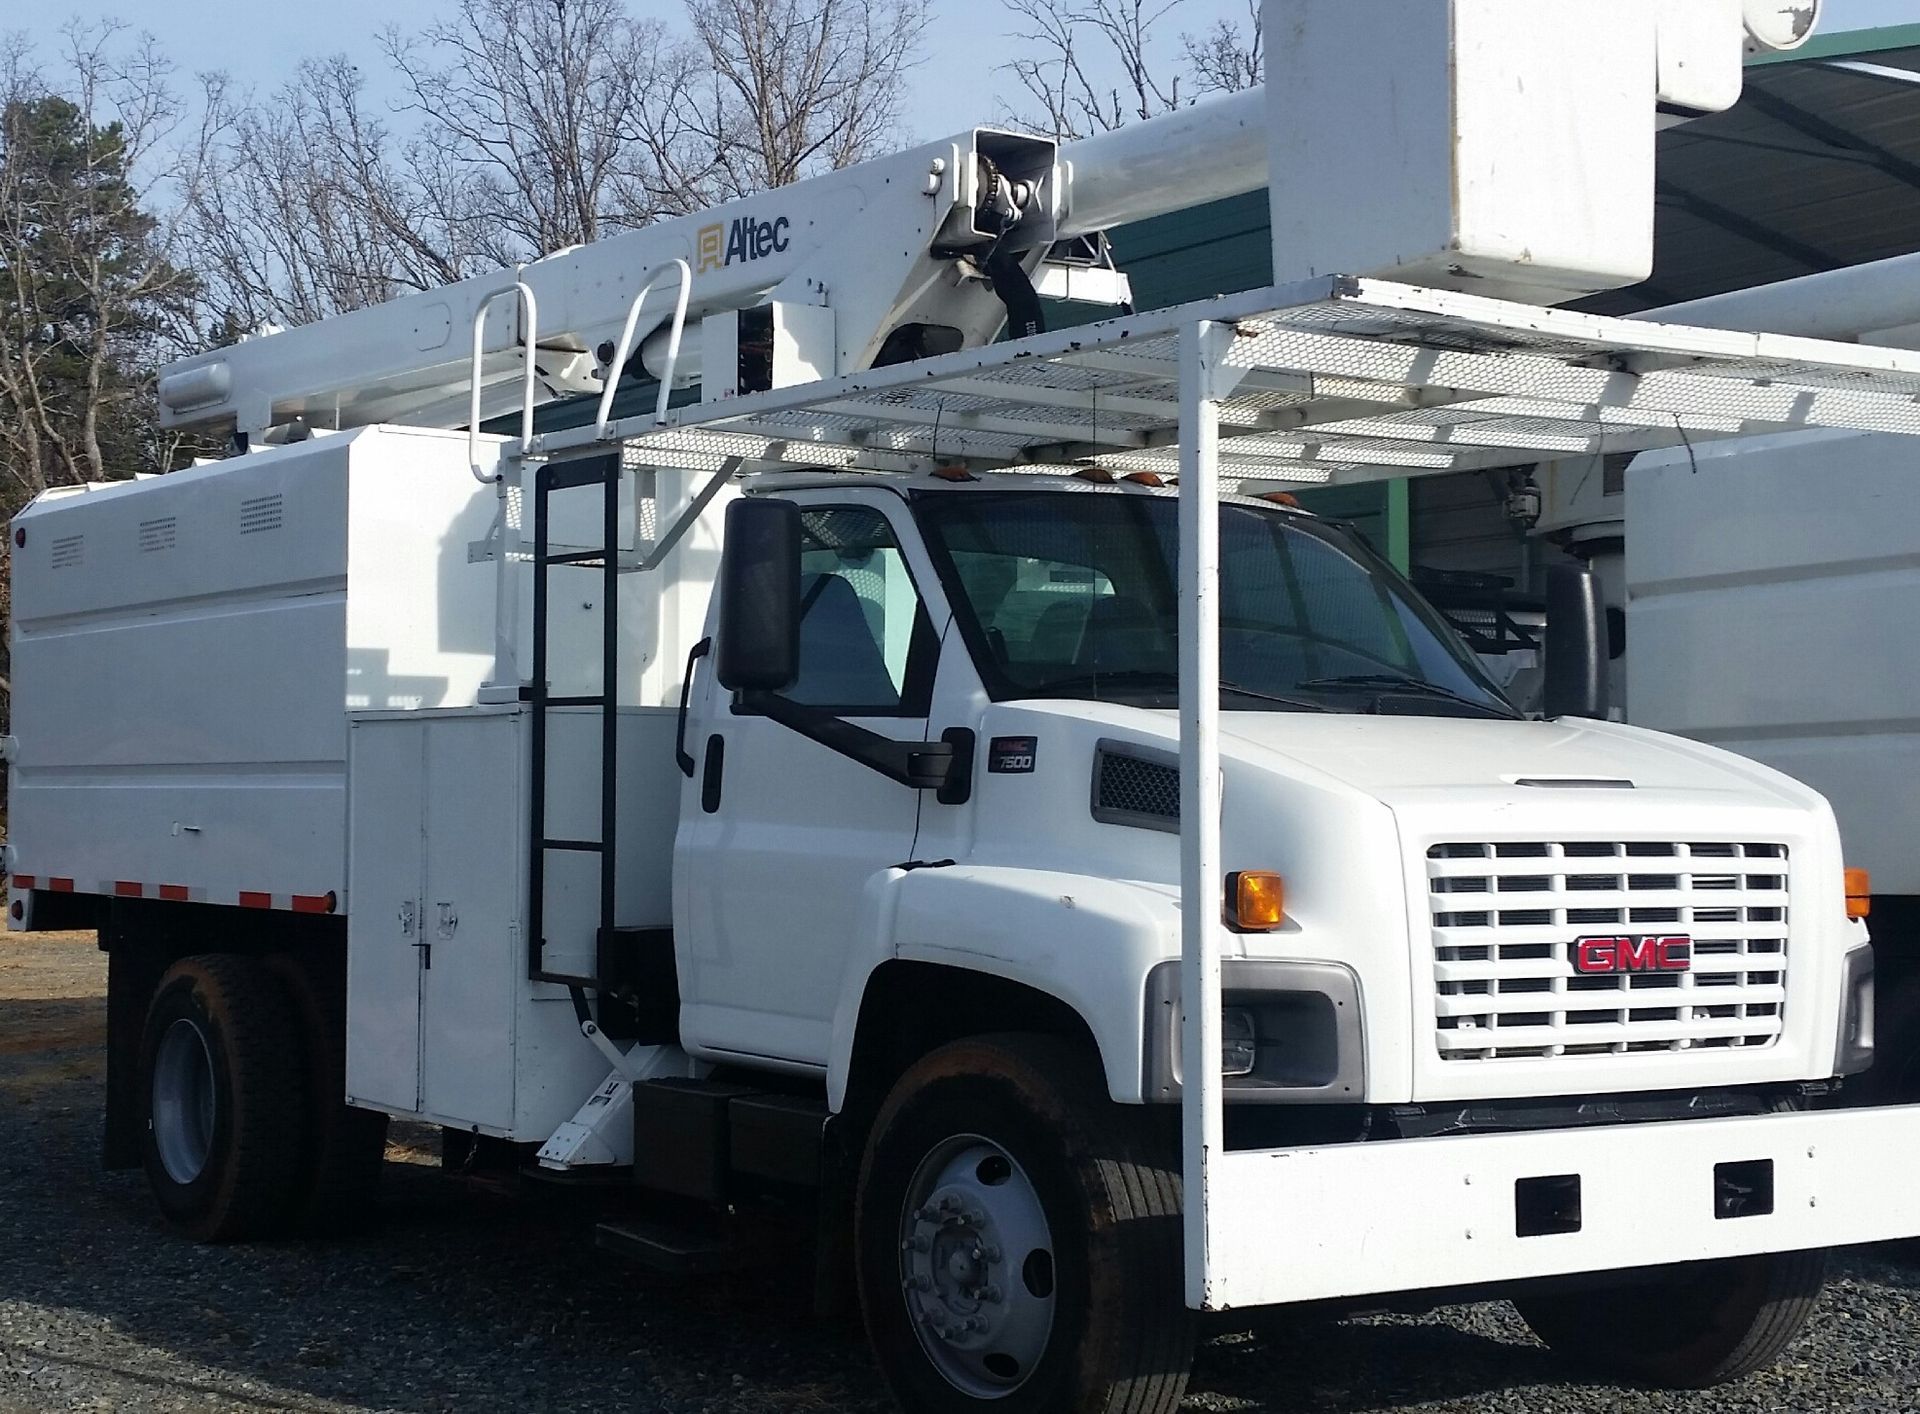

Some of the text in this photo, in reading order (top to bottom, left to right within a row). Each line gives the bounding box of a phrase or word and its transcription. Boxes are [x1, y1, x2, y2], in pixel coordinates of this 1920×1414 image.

[724, 216, 790, 266] Altec
[1000, 755, 1032, 769] 7500
[1578, 936, 1690, 972] GMC
